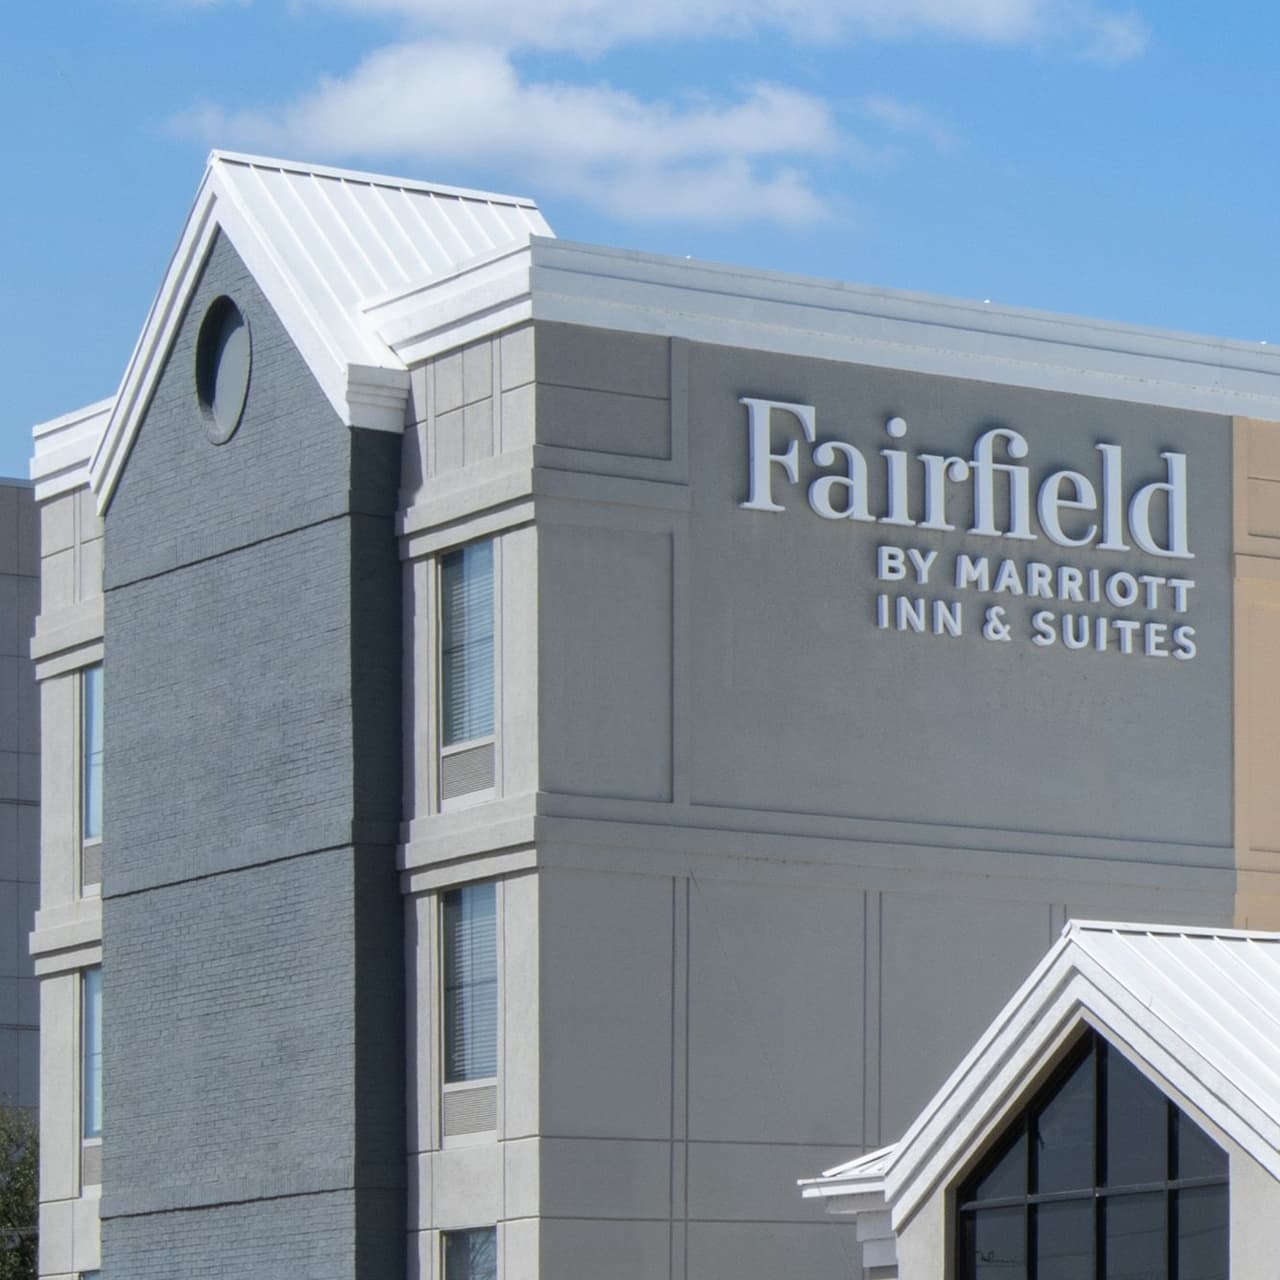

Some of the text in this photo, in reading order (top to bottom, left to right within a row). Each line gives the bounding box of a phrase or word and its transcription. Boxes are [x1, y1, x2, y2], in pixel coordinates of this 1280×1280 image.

[739, 397, 1195, 559] Fairfield
[877, 545, 1196, 613] BY MARRIOTT
[877, 594, 1198, 661] INN & SUITES
